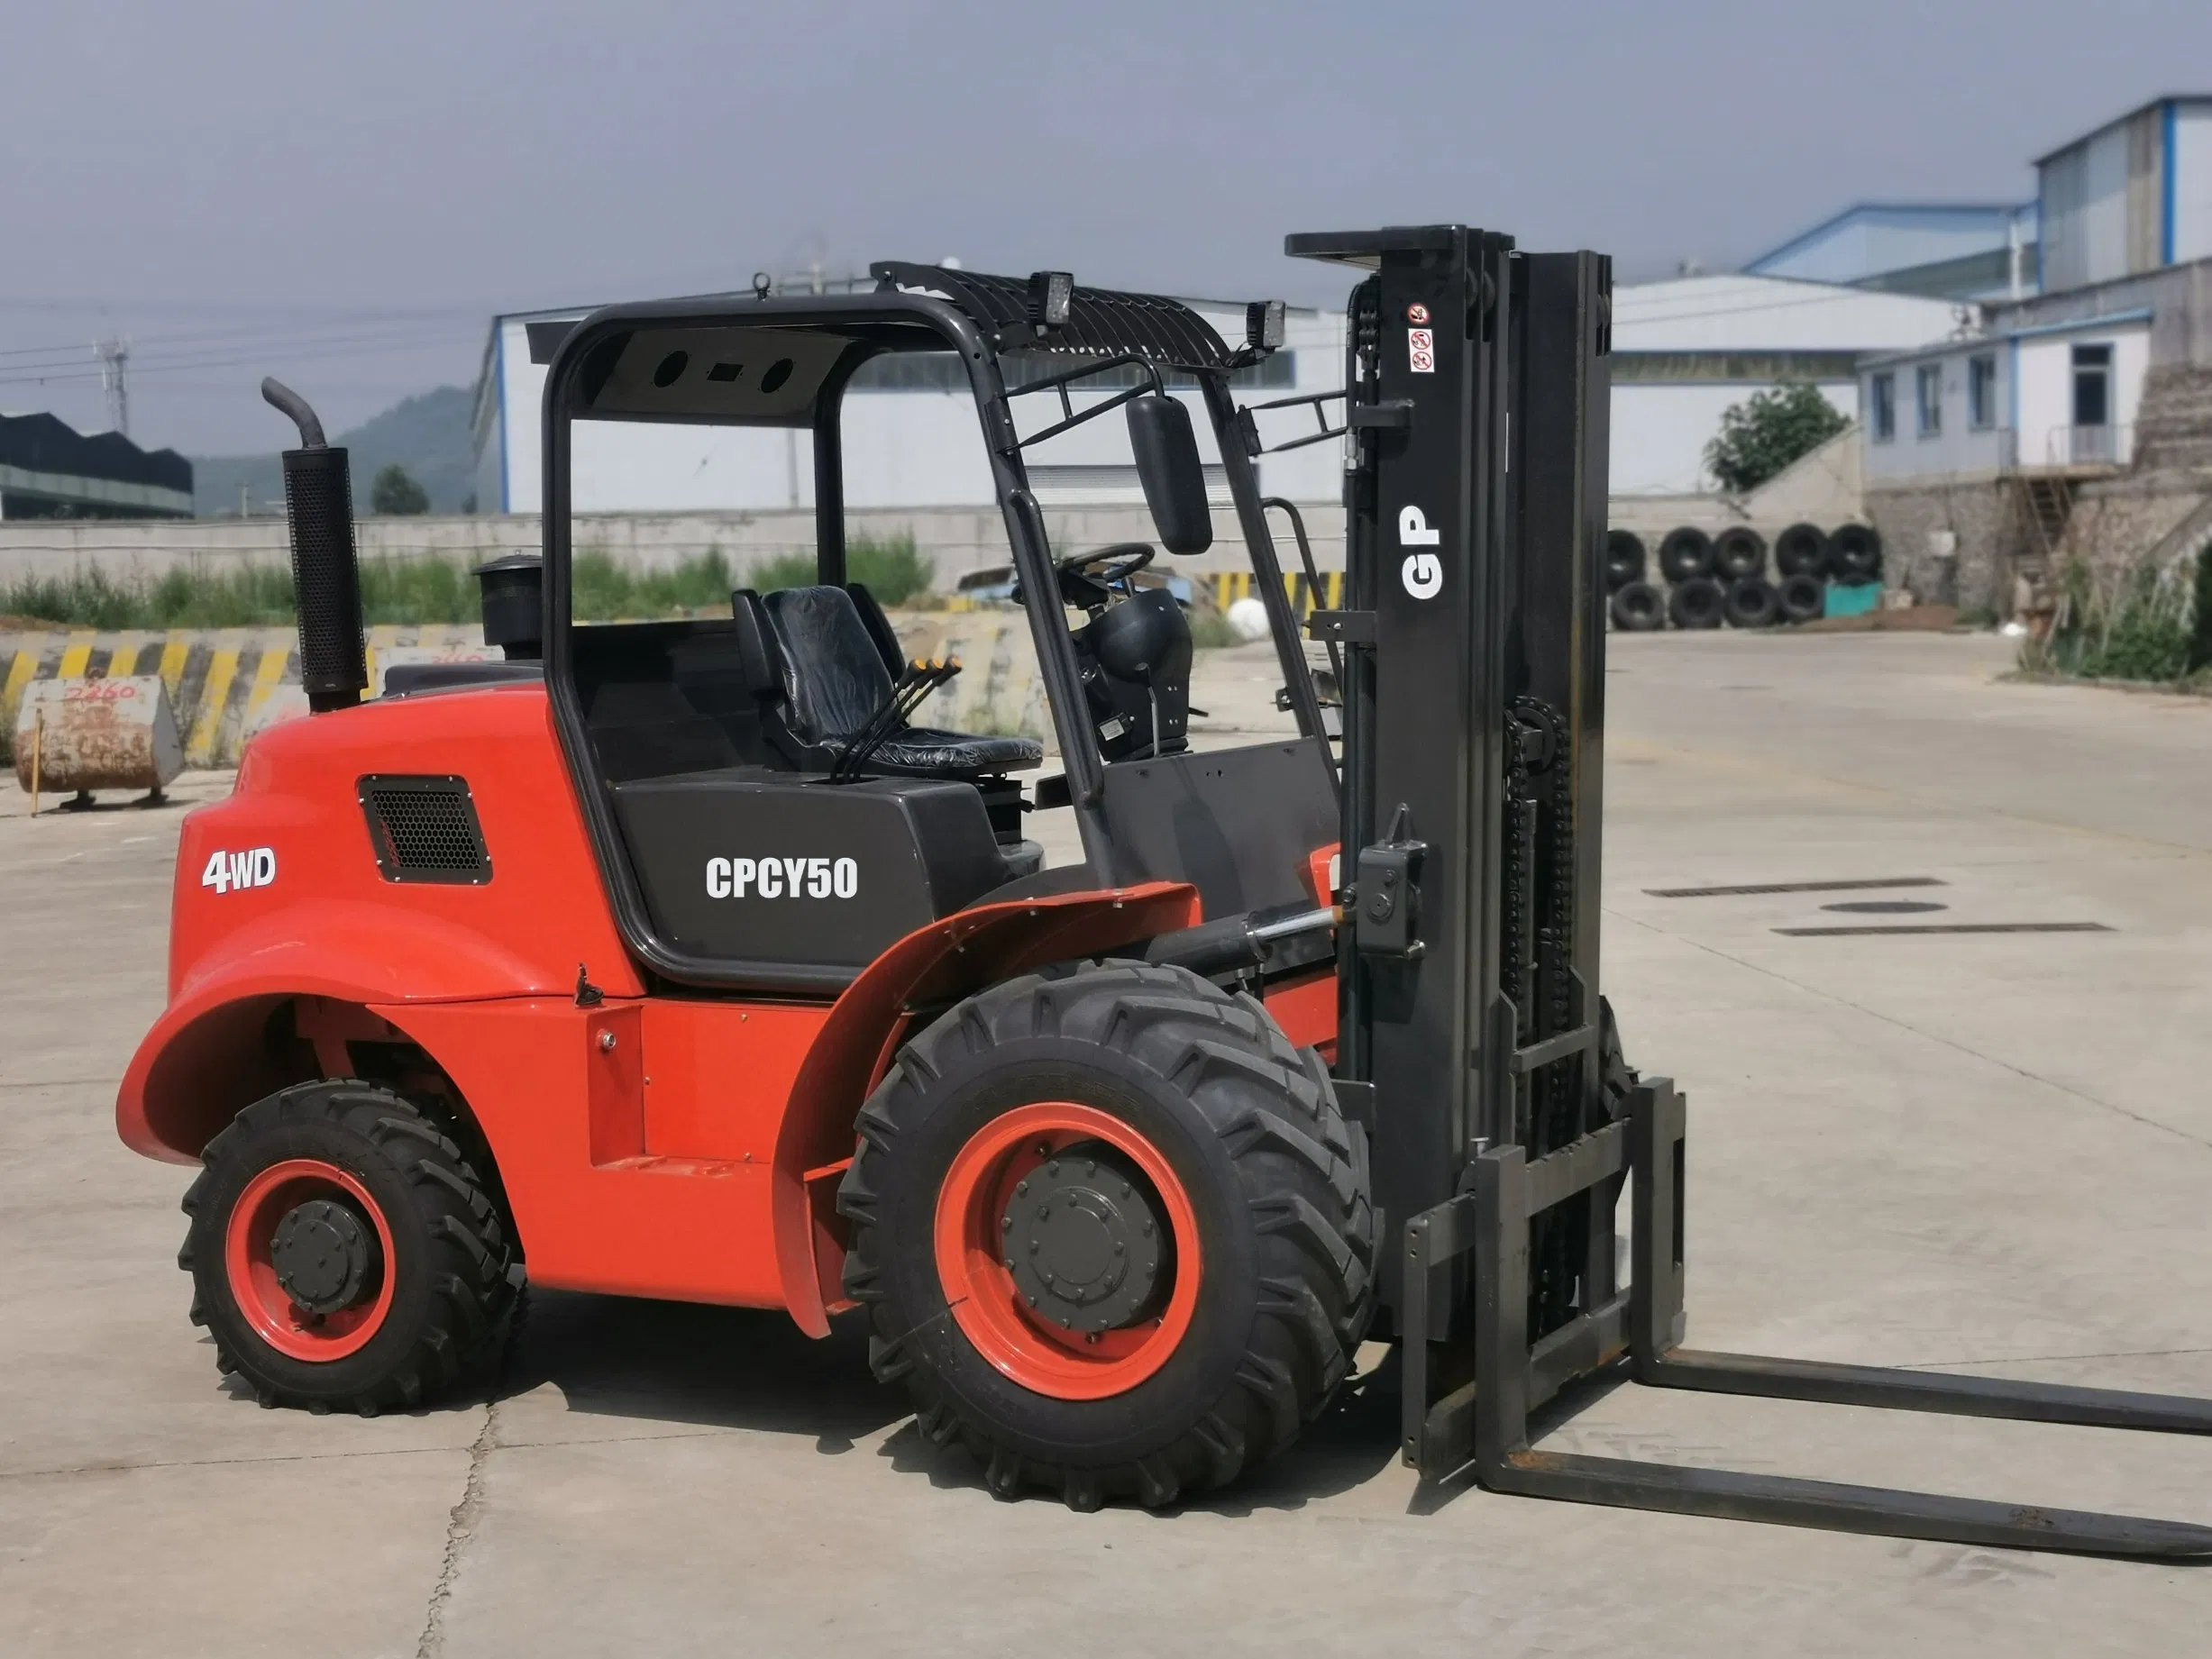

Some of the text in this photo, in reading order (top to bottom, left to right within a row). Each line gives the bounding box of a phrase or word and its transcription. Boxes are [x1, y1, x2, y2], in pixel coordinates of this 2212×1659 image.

[1399, 506, 1442, 600] GP
[201, 847, 277, 895] 4WD
[706, 857, 858, 899] CPCY50
